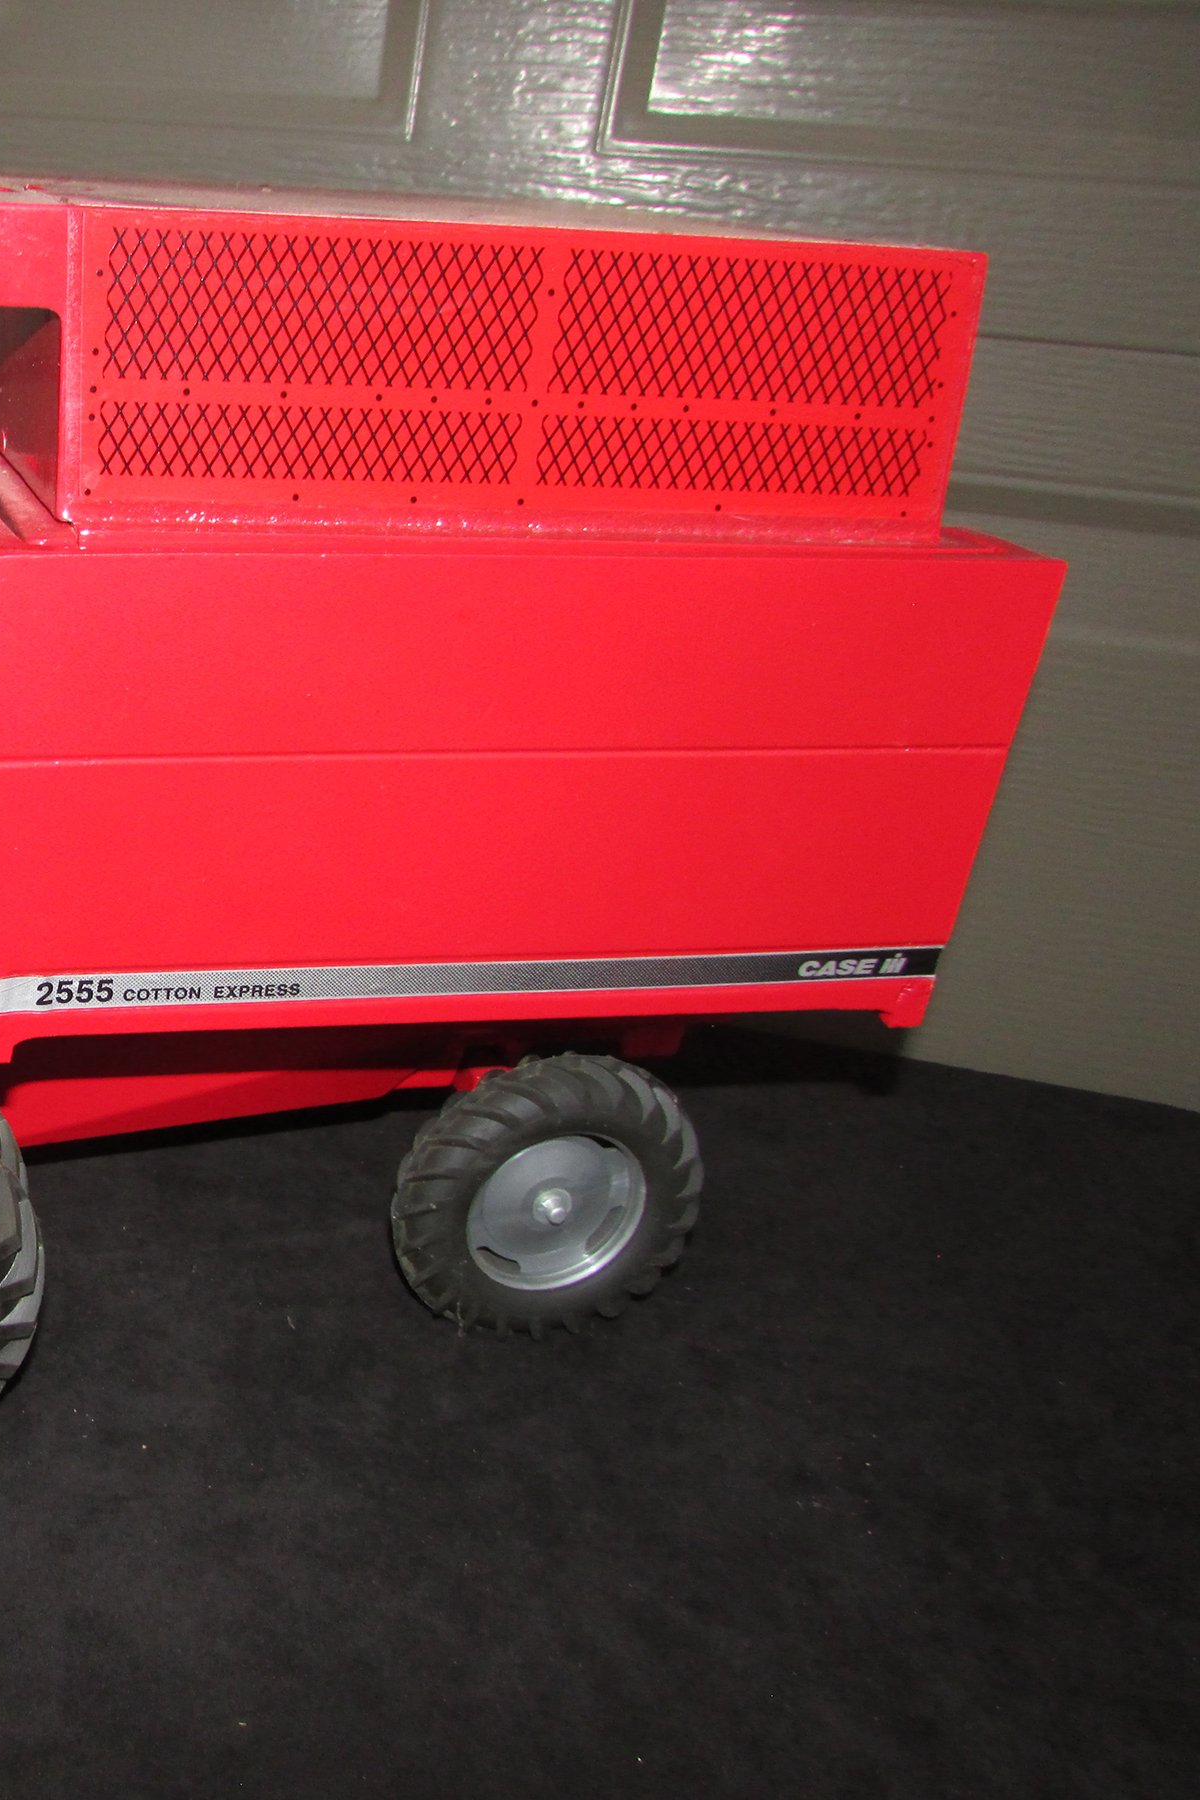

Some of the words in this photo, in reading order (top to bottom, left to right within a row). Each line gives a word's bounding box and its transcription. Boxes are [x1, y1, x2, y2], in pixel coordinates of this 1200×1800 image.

[797, 957, 878, 978] CASE
[35, 979, 114, 1006] 2555
[122, 986, 201, 1001] COTTON
[213, 983, 301, 999] EXPRESS
